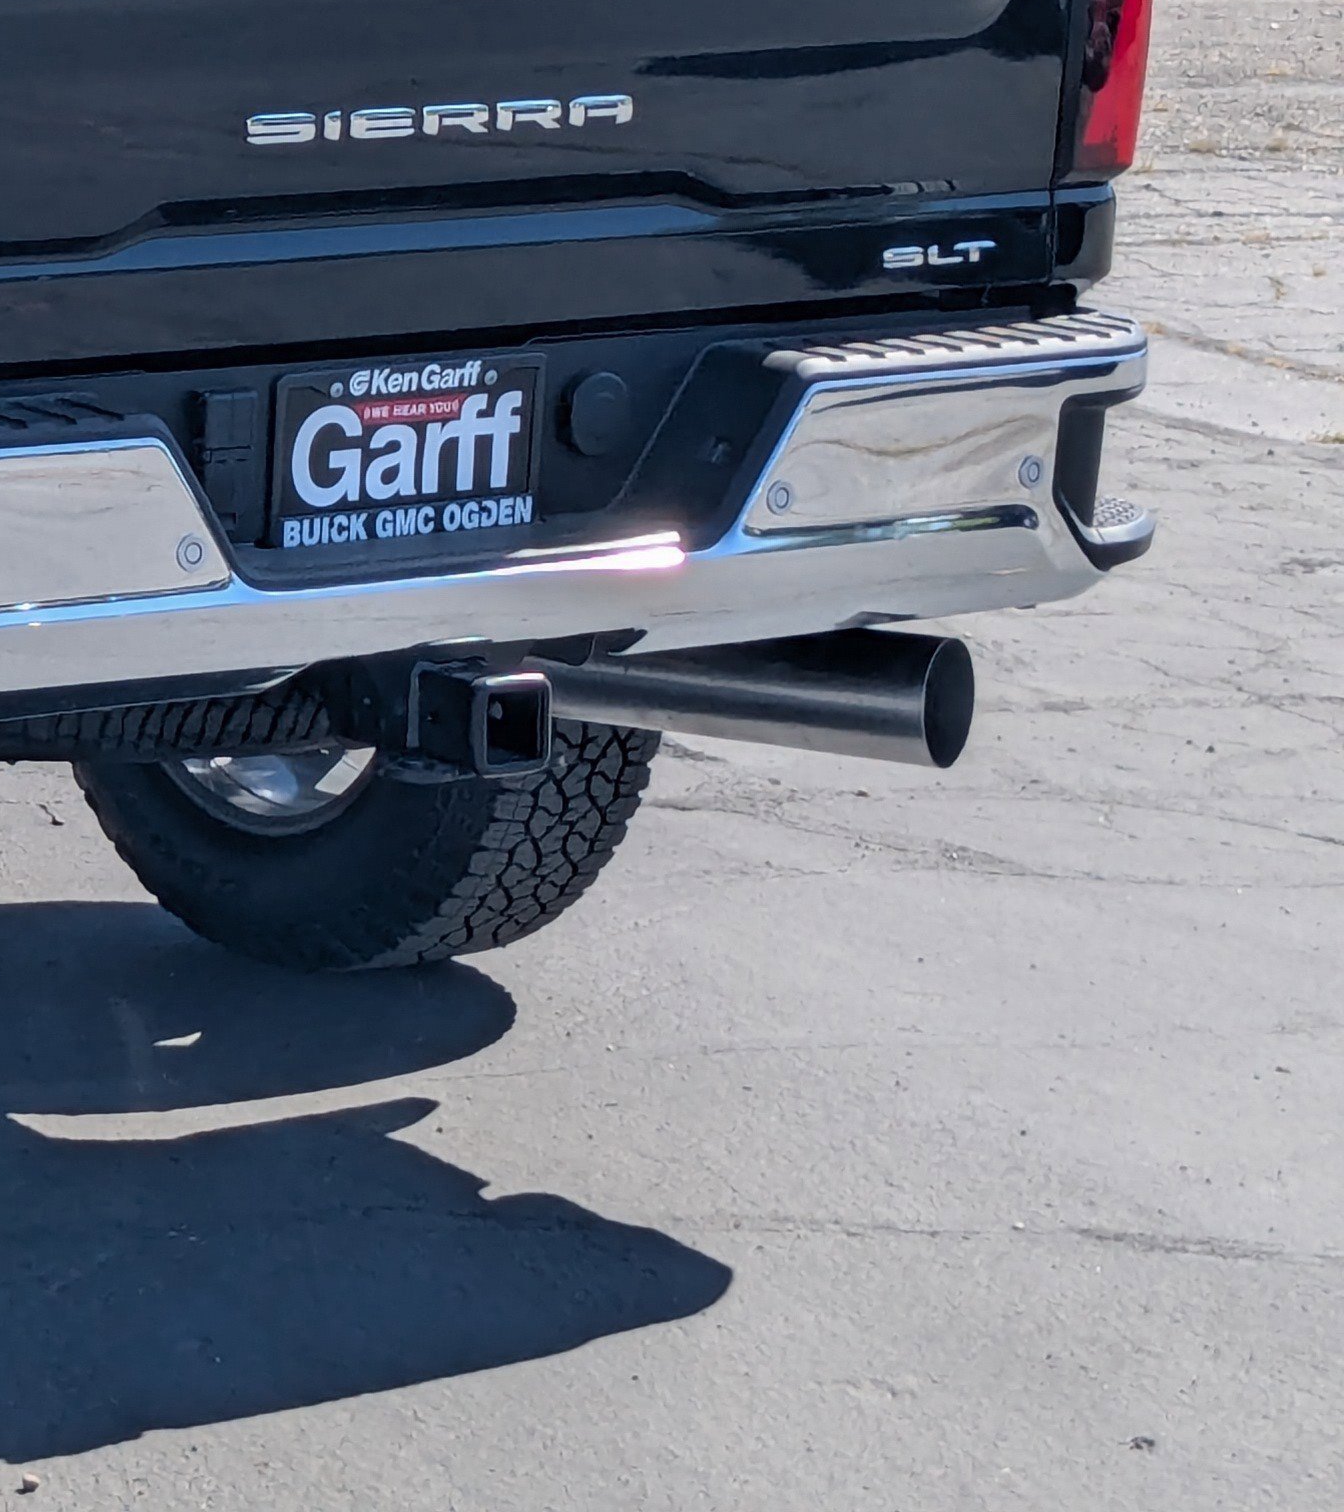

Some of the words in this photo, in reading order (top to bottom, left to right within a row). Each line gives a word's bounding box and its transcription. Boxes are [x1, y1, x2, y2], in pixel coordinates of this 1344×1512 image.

[246, 95, 633, 145] SIERRA
[883, 240, 997, 269] SLT
[292, 391, 522, 507] Garff
[283, 512, 368, 548] BUICK
[376, 506, 435, 538] GMC
[443, 495, 533, 531] OGDEN
